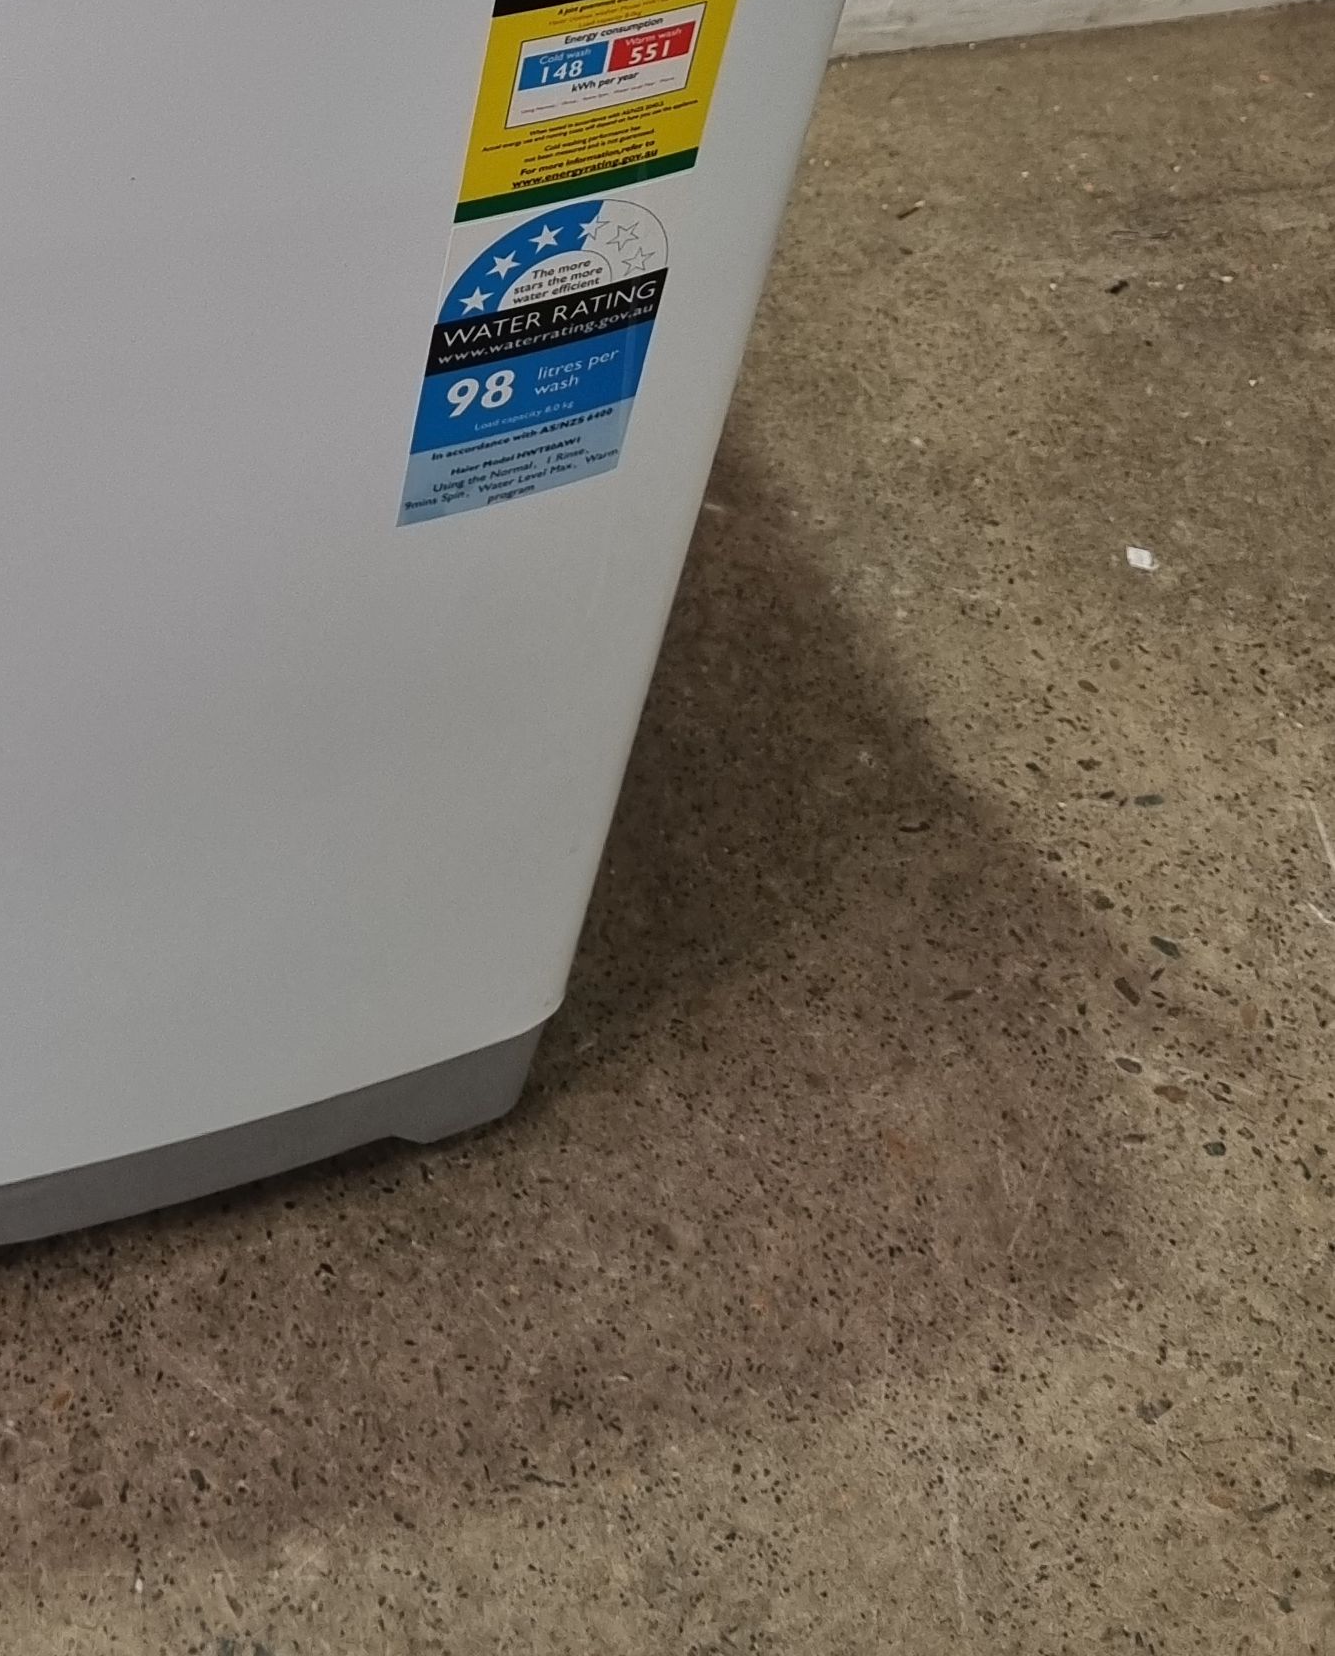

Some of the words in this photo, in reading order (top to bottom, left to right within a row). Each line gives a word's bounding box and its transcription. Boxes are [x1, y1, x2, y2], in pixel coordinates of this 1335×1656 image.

[564, 30, 598, 45] Energy
[600, 17, 664, 37] consumption
[625, 33, 656, 46] Warm
[658, 27, 682, 40] wash
[539, 52, 565, 65] Cold
[567, 47, 592, 59] wash
[628, 40, 670, 66] 551
[541, 59, 584, 84] 148
[571, 80, 597, 93] kWh
[598, 76, 615, 89] per
[617, 71, 640, 86] year
[512, 149, 658, 189] www.energyrating.gov.au
[520, 168, 536, 176] For
[538, 162, 564, 172] more
[514, 281, 544, 294] stars
[547, 274, 568, 286] the
[570, 266, 603, 281] more
[532, 267, 556, 280] The
[558, 259, 592, 275] more
[512, 290, 548, 305] water
[551, 277, 600, 295] efficient
[443, 311, 541, 347] WATER
[552, 280, 657, 323] RATING
[438, 304, 653, 365] www.waterrating.gov.au
[537, 360, 582, 381] litres
[587, 349, 620, 371] per
[447, 369, 515, 418] 98
[534, 375, 579, 395] wash
[474, 417, 500, 432] Load
[501, 408, 542, 427] capacity
[432, 452, 444, 461] In
[446, 437, 510, 458] accordance
[513, 430, 538, 441] with
[451, 464, 480, 475] Haier
[482, 454, 515, 468] Model
[478, 478, 515, 492] Water
[518, 468, 547, 483] Level
[586, 449, 618, 463] Warm
[433, 480, 465, 493] Using
[468, 475, 487, 485] the
[487, 485, 535, 505] program
